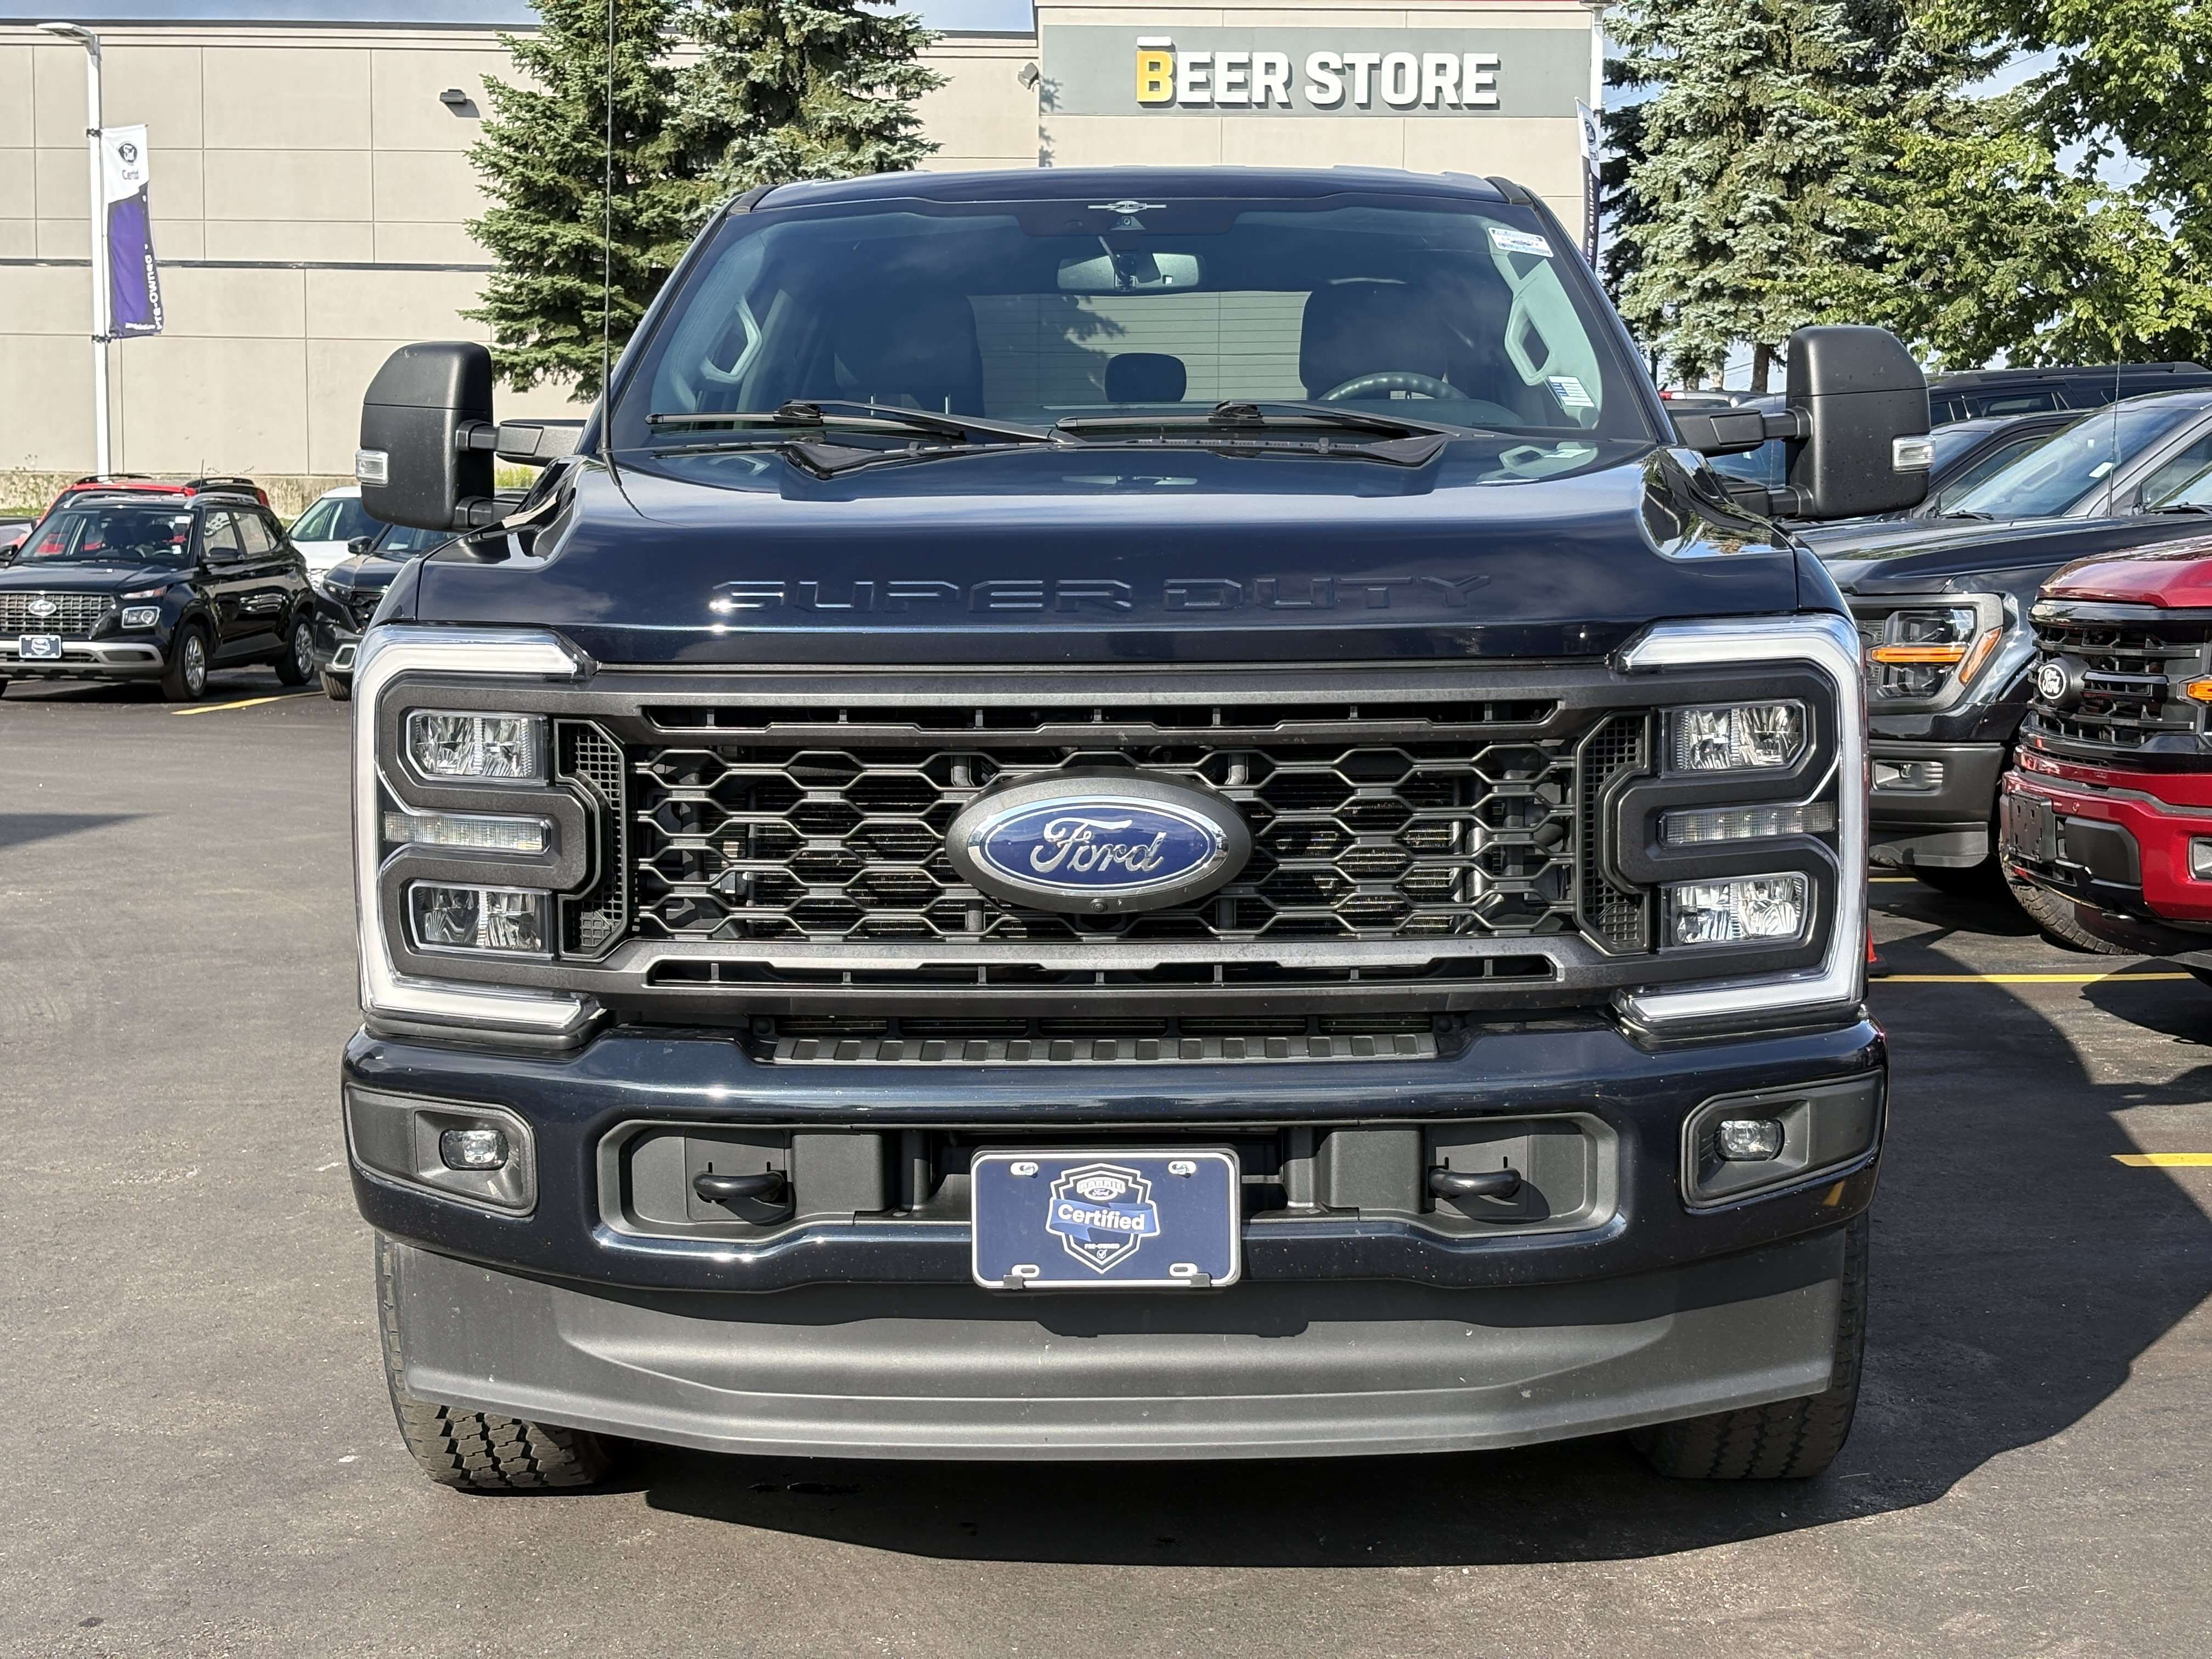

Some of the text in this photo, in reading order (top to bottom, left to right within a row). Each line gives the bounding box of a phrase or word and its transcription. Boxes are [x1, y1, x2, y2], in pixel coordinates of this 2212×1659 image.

[1137, 50, 1498, 104] BEER STORE
[709, 575, 1492, 613] SUPER DUTY
[2042, 668, 2061, 694] Ford
[1029, 816, 1167, 873] Ford
[1058, 1204, 1145, 1230] Certified
